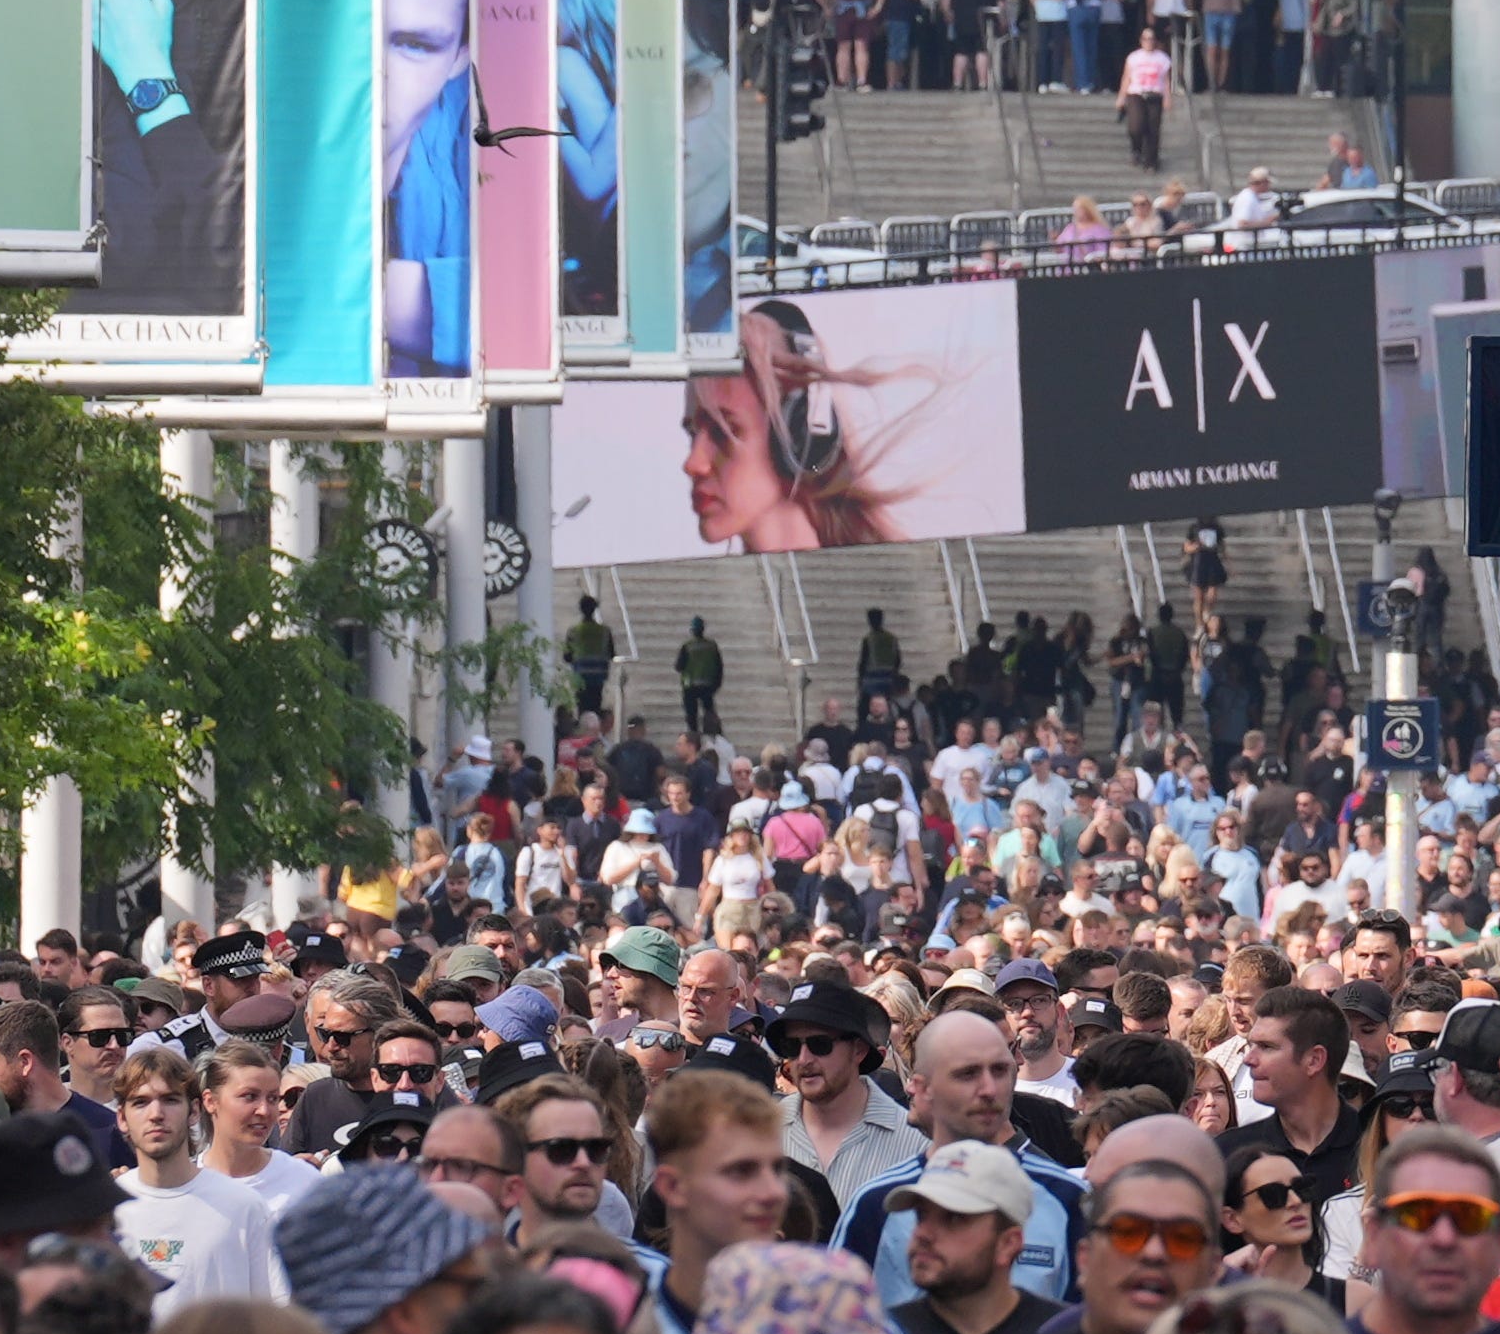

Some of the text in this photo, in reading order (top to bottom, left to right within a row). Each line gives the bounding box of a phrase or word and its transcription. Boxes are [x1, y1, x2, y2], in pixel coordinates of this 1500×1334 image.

[80, 320, 229, 342] EXCHANGE
[1127, 461, 1280, 490] ARMANI EXCHANGE
